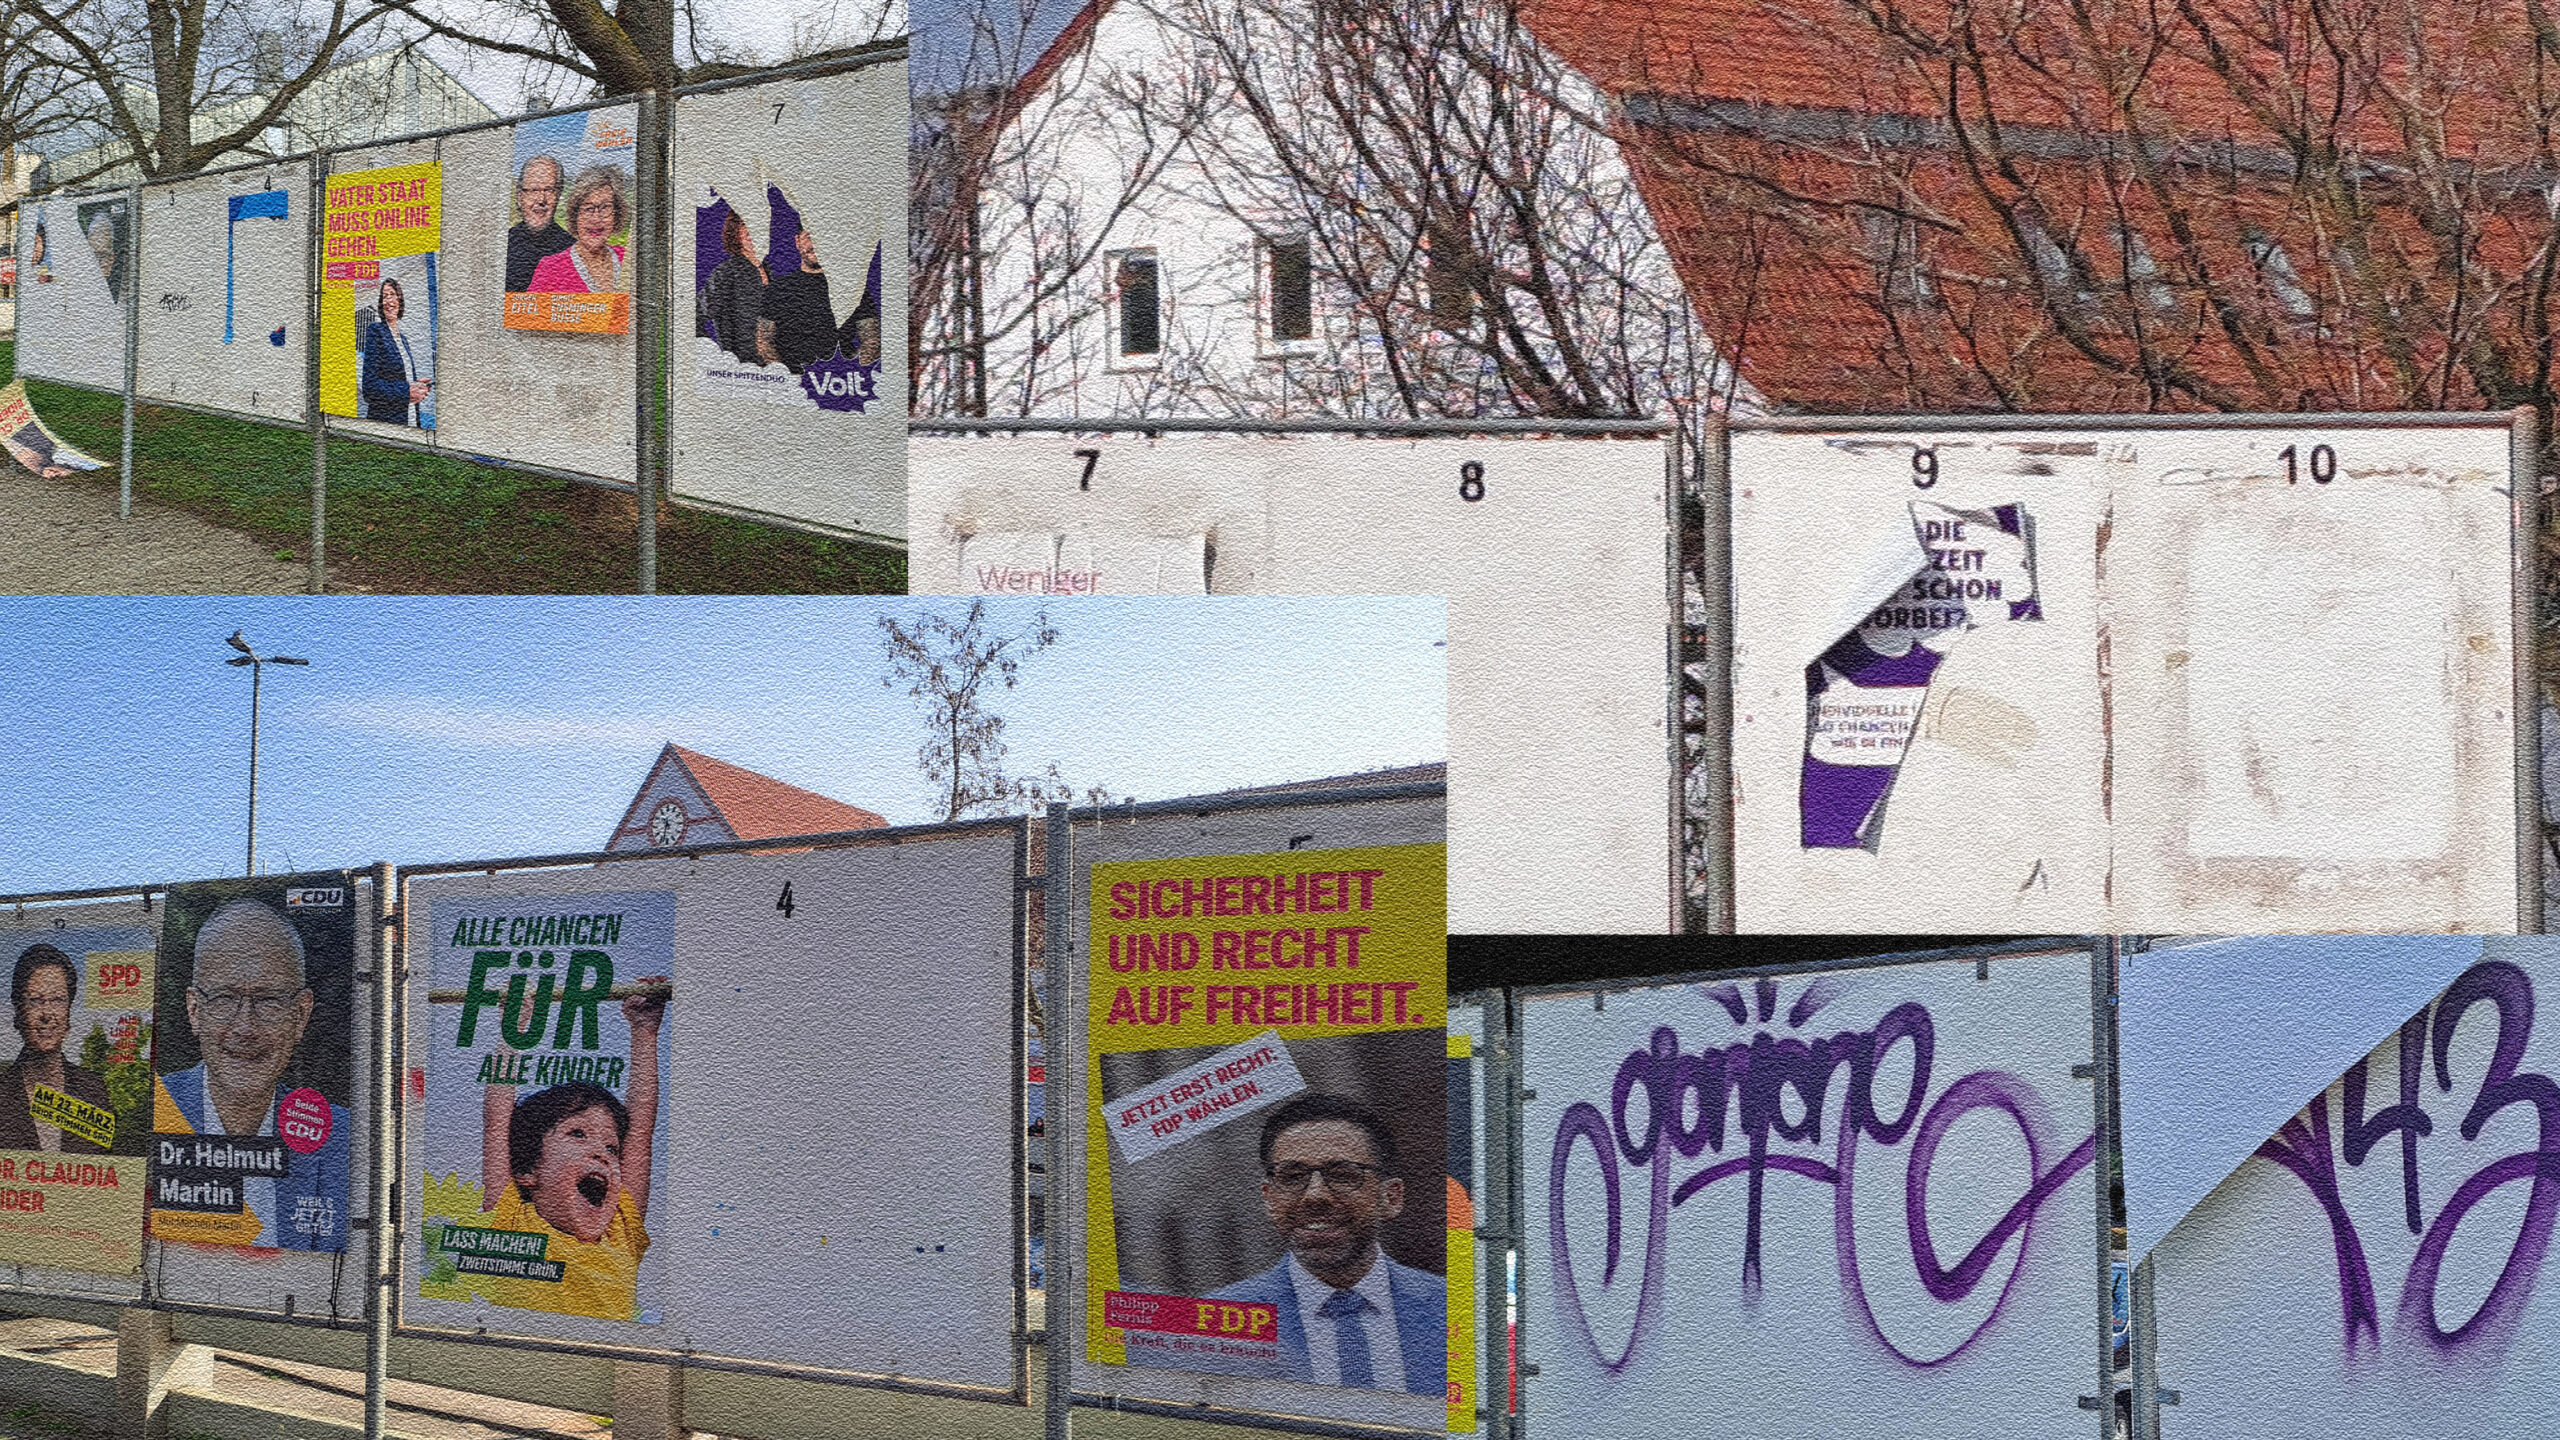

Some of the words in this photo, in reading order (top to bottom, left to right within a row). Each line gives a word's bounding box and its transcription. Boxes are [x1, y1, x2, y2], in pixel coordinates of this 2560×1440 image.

[773, 103, 785, 125] 7
[329, 184, 375, 209] VATER
[378, 178, 429, 203] STAAT
[328, 210, 370, 233] MUSS
[374, 205, 431, 230] ONLINE
[327, 236, 381, 257] GEHEN.
[354, 263, 379, 278] FDP
[512, 302, 539, 314] EITEL
[707, 369, 732, 378] UNSER
[734, 371, 786, 384] SPITZENDUO
[808, 371, 869, 397] Volt
[1074, 451, 1100, 492] 7
[1911, 448, 1939, 490] 9
[2278, 444, 2338, 485] 10
[1459, 461, 1486, 502] 8
[1925, 520, 1967, 542] DIE
[1929, 549, 1987, 571] ZEIT
[976, 564, 1102, 596] Weniger
[1912, 577, 2002, 601] SCHON
[301, 890, 341, 904] CDU
[776, 881, 795, 919] 4
[1108, 869, 1385, 921] SICHERHEIT
[450, 916, 507, 948] ALLE
[509, 914, 623, 947] CHANCEN
[1108, 931, 1201, 973] UND
[1211, 926, 1372, 972] RECHT
[98, 964, 141, 989] SPD
[1106, 985, 1195, 1027] AUF
[1206, 981, 1425, 1027] FREIHEIT.
[477, 1054, 534, 1086] ALLE
[534, 1055, 625, 1089] KINDER
[35, 1087, 55, 1106] AM
[294, 1098, 320, 1113] Beide
[1120, 1094, 1169, 1129] JETZT
[1169, 1072, 1215, 1105] ERST
[1150, 1113, 1184, 1139] FDP
[1184, 1080, 1265, 1123] WÄHLEN.
[55, 1114, 92, 1137] STIMMEN
[285, 1120, 323, 1141] CDU
[286, 1107, 325, 1126] Stimmen
[160, 1141, 191, 1167] Dr.
[195, 1142, 283, 1171] Helmut
[0, 1158, 19, 1182] R.
[24, 1160, 119, 1189] CLAUDIA
[159, 1178, 235, 1206] Martin
[443, 1229, 479, 1250] LASS
[479, 1232, 541, 1257] MACHEN!
[459, 1255, 528, 1276] ZWEITSTIMME
[1110, 1296, 1160, 1314] Philipp
[1195, 1303, 1271, 1335] FDP
[1173, 1338, 1195, 1350] die
